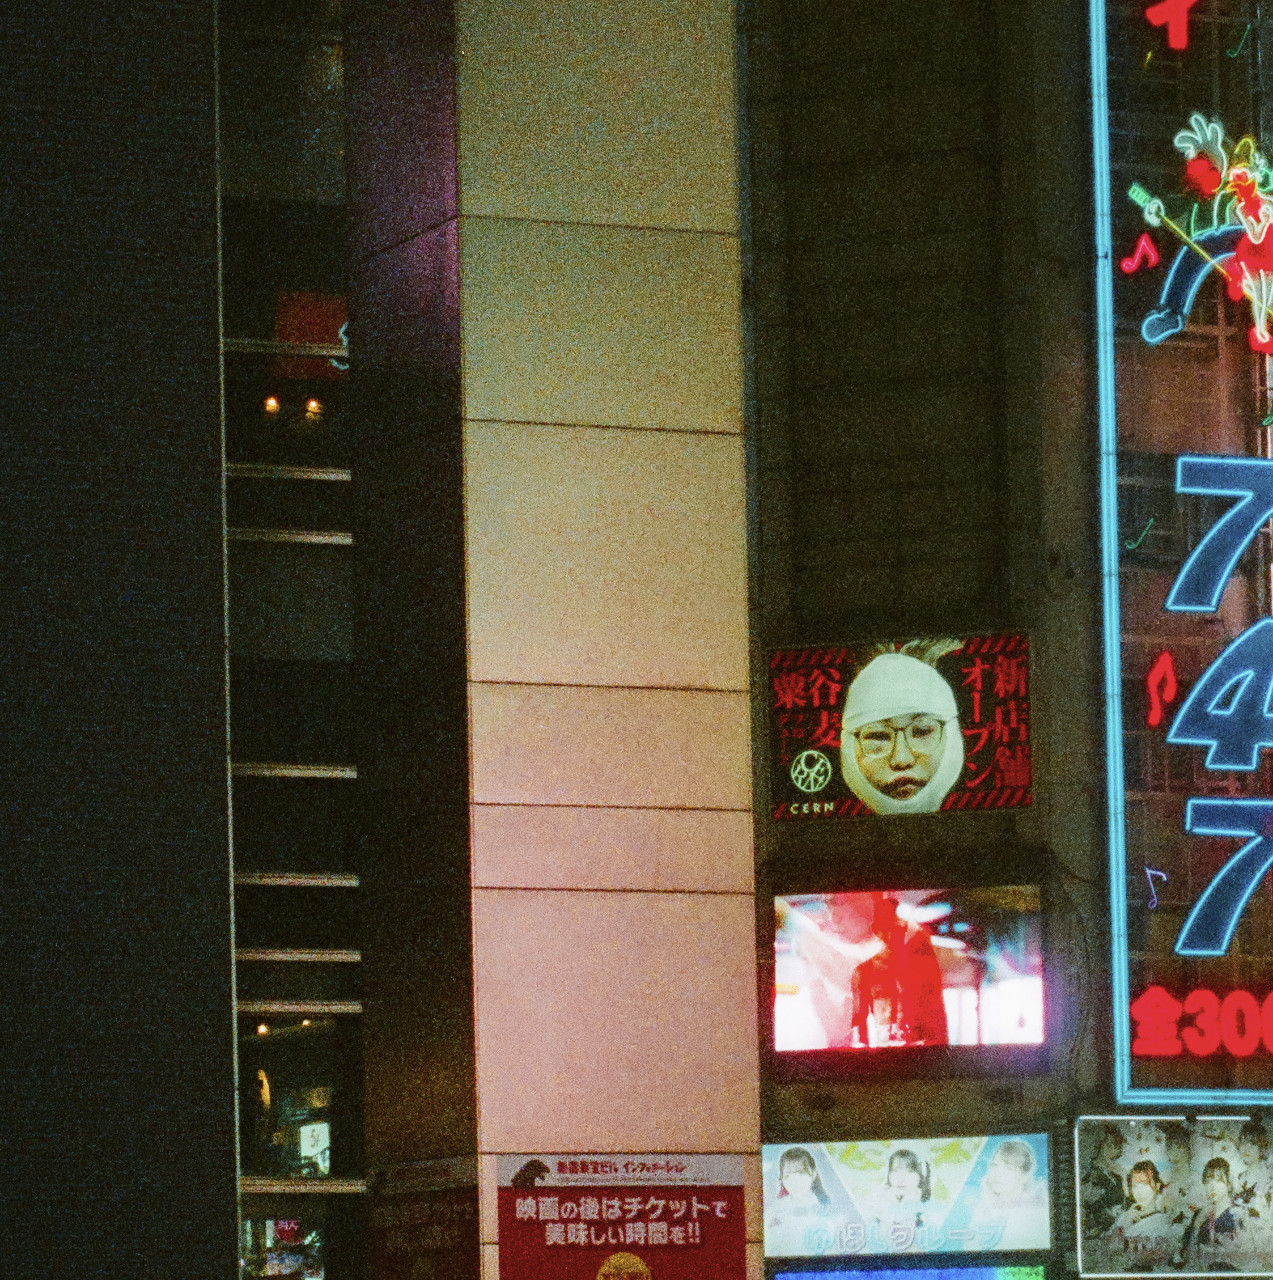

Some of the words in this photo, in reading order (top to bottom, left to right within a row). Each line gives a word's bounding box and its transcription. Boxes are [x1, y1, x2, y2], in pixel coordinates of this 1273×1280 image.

[962, 657, 992, 789] オープン
[790, 802, 835, 815] CERN
[515, 1195, 728, 1221] 映画の後はチケットで
